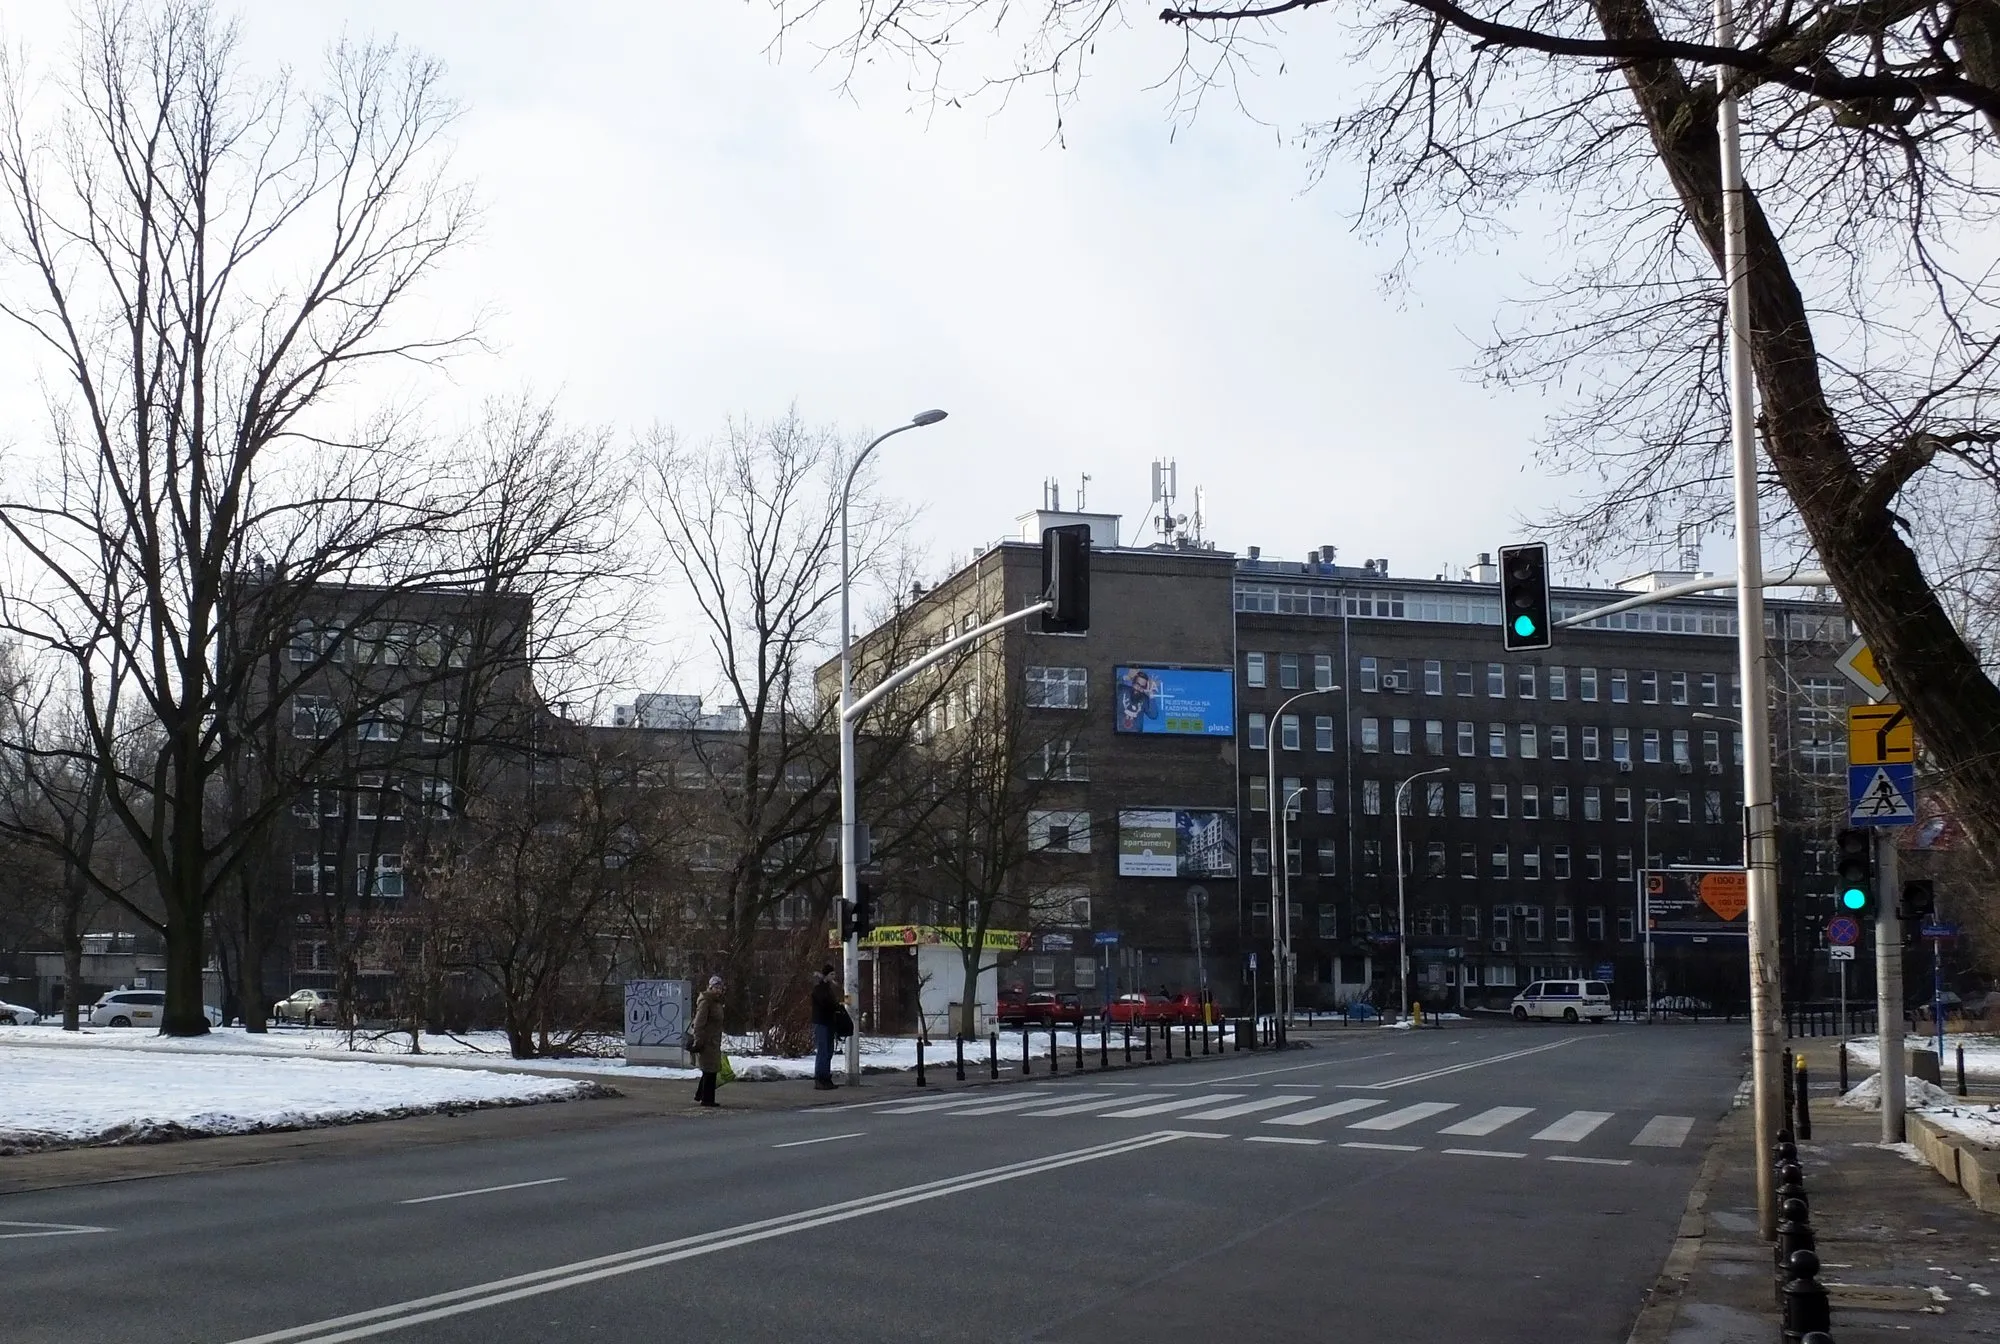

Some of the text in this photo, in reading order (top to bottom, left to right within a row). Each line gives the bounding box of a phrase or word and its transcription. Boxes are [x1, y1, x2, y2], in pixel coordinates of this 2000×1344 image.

[1208, 723, 1224, 732] plus
[1123, 840, 1172, 849] apartamenty
[990, 933, 1018, 946] OWOCE
